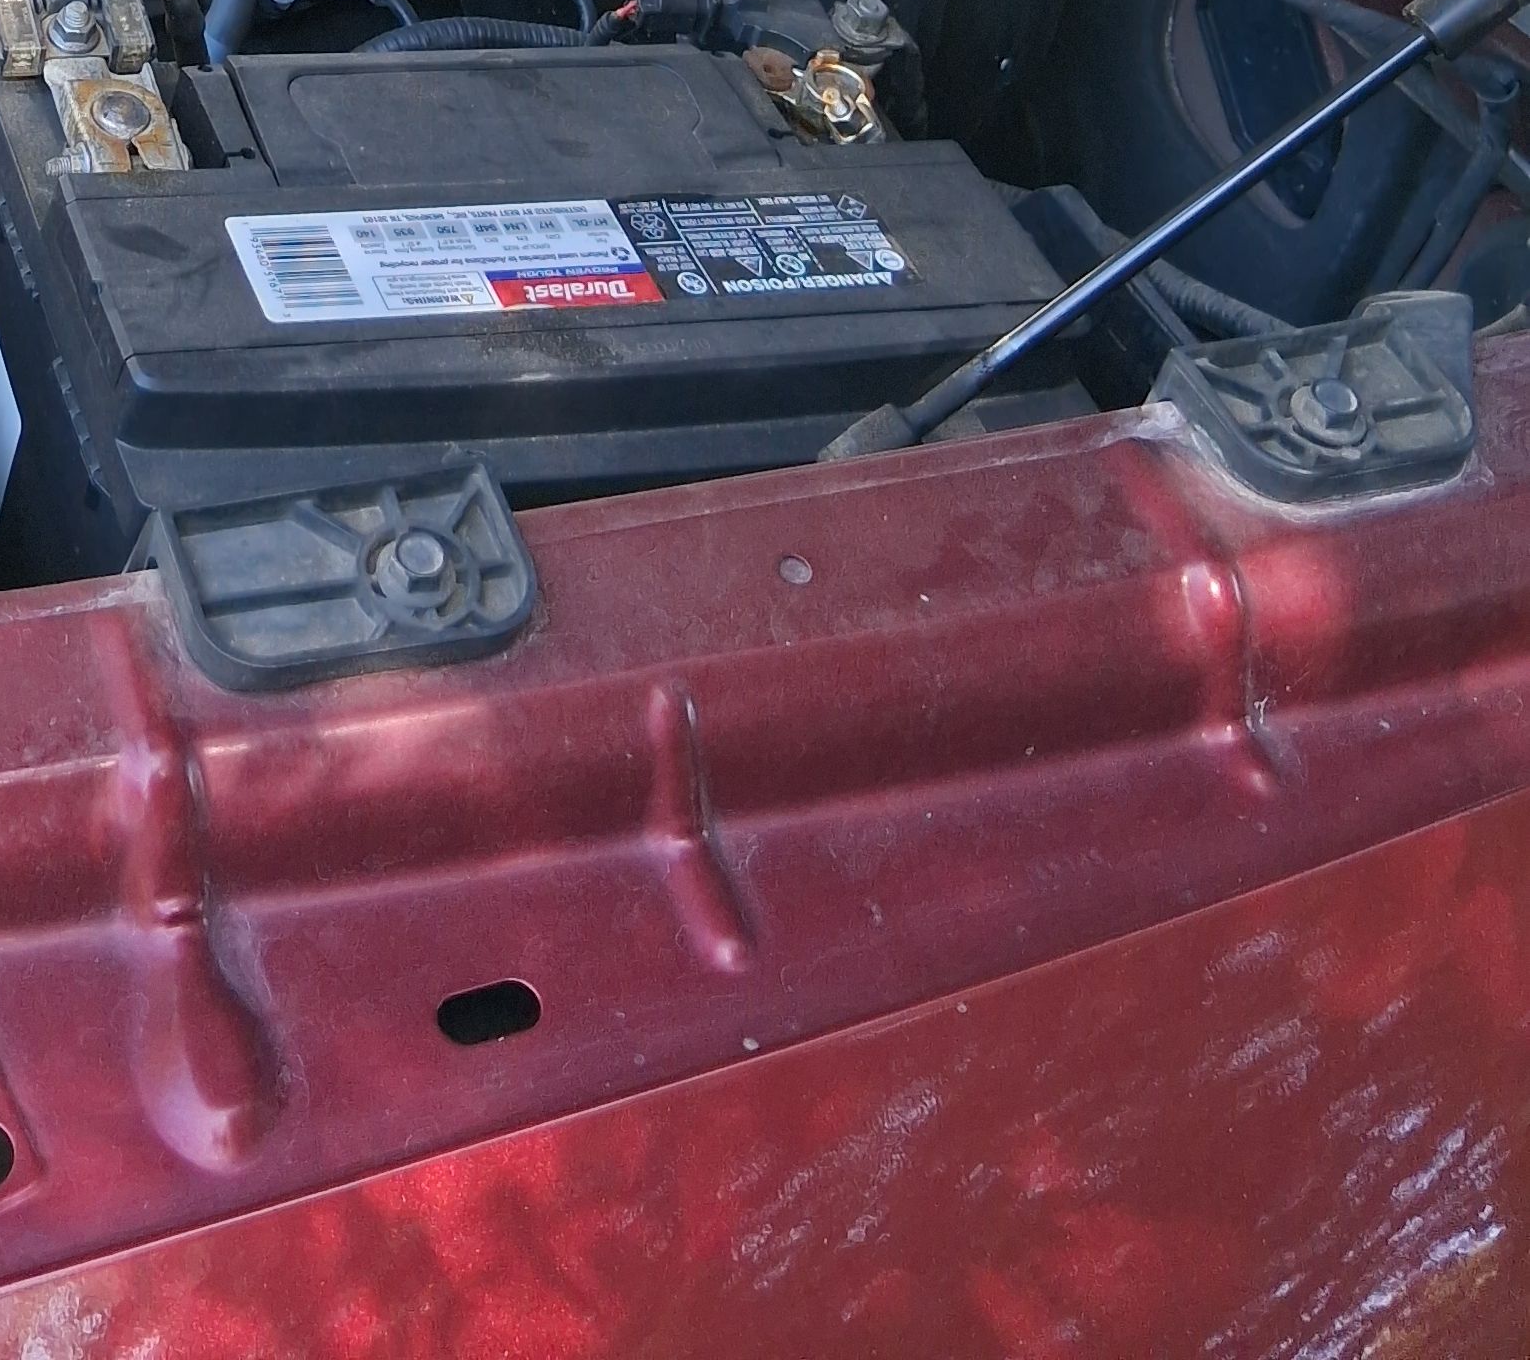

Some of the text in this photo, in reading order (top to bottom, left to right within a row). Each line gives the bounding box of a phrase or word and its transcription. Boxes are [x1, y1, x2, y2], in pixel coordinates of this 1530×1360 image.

[433, 225, 458, 234] 750
[471, 223, 500, 233] 94R
[500, 221, 529, 231] LN4
[534, 220, 557, 230] H7
[353, 229, 378, 238] 140
[390, 227, 417, 236] 935
[514, 265, 622, 278] PROVEN TOUGH
[718, 271, 882, 293] DANGER/POISON
[517, 279, 638, 303] Duralast
